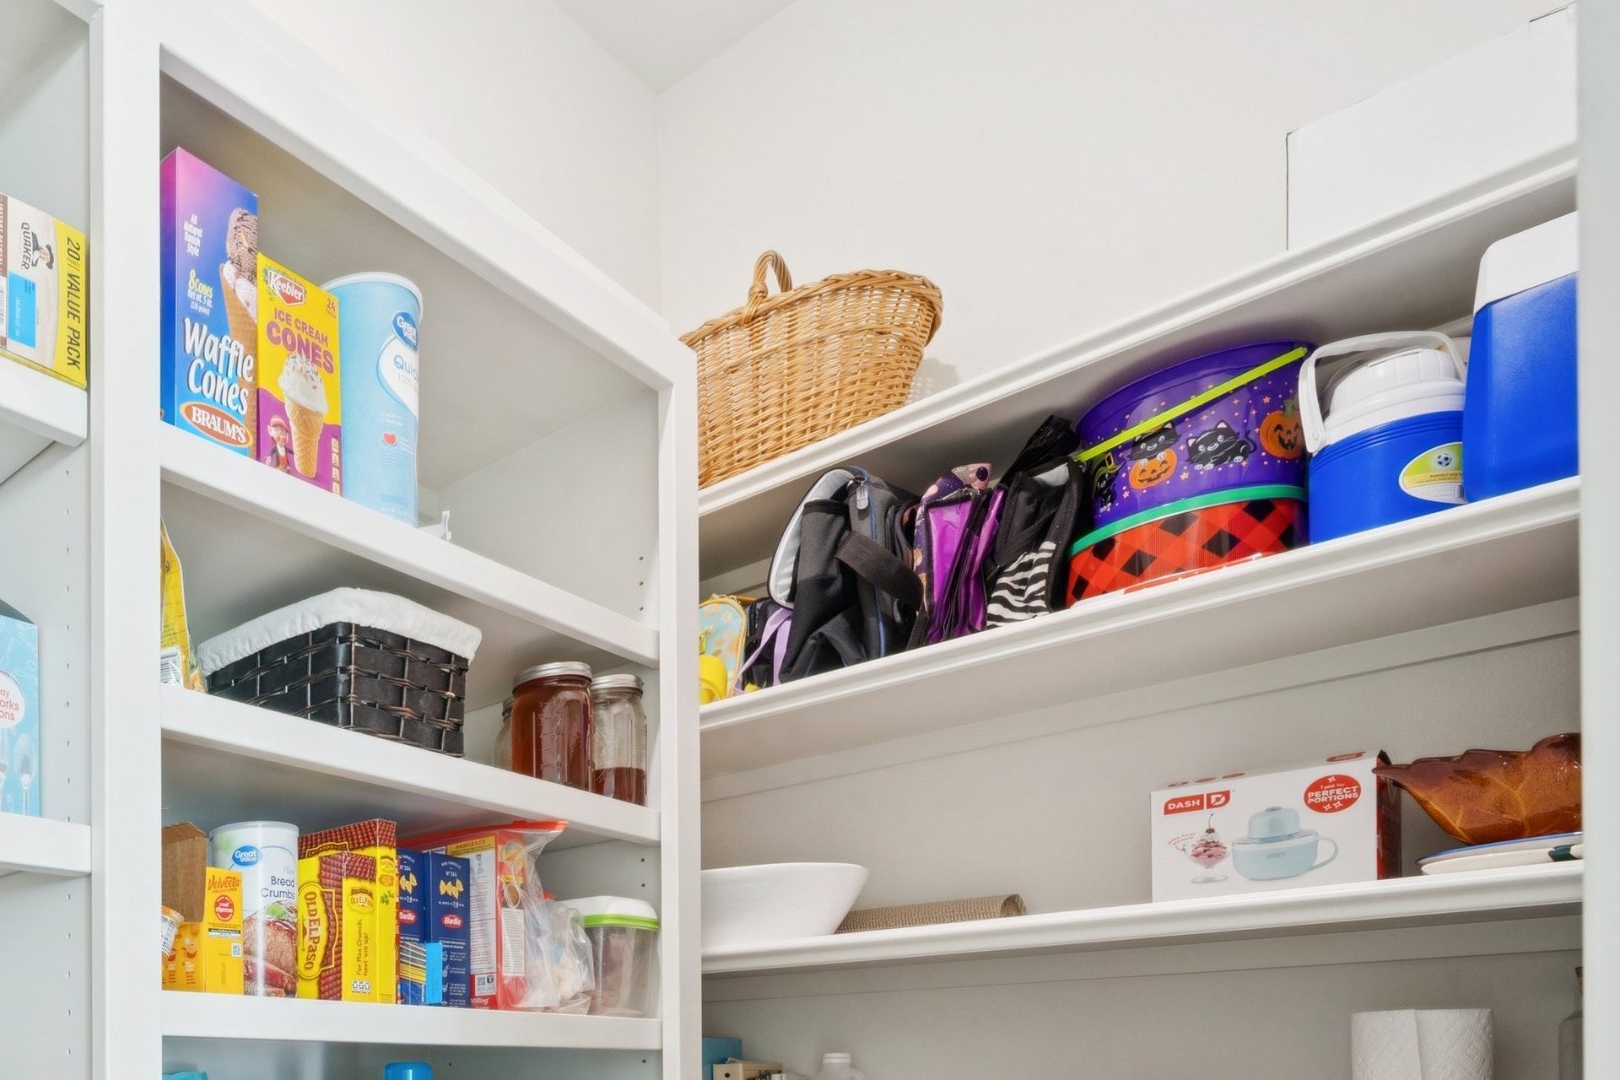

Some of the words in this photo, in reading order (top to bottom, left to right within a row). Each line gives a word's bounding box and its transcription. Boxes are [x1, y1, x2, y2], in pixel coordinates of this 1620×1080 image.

[20, 222, 31, 270] QUAKER
[67, 236, 80, 261] 20
[67, 272, 80, 323] VALUE
[189, 269, 196, 291] 8
[195, 281, 214, 299] Cones
[268, 270, 305, 302] Keebler
[274, 308, 292, 324] ICE
[294, 318, 329, 348] CREAM
[67, 325, 80, 370] PACK
[183, 318, 255, 383] Waffle
[266, 320, 336, 375] CONES
[188, 358, 249, 416] Cones
[191, 407, 247, 445] BRAUM'S
[1167, 797, 1201, 812] DASH
[1307, 793, 1360, 806] PORTIONS
[1308, 786, 1360, 800] PERFECT
[234, 849, 258, 860] Great
[208, 874, 241, 891] Velveeta
[443, 916, 462, 927] Barilla
